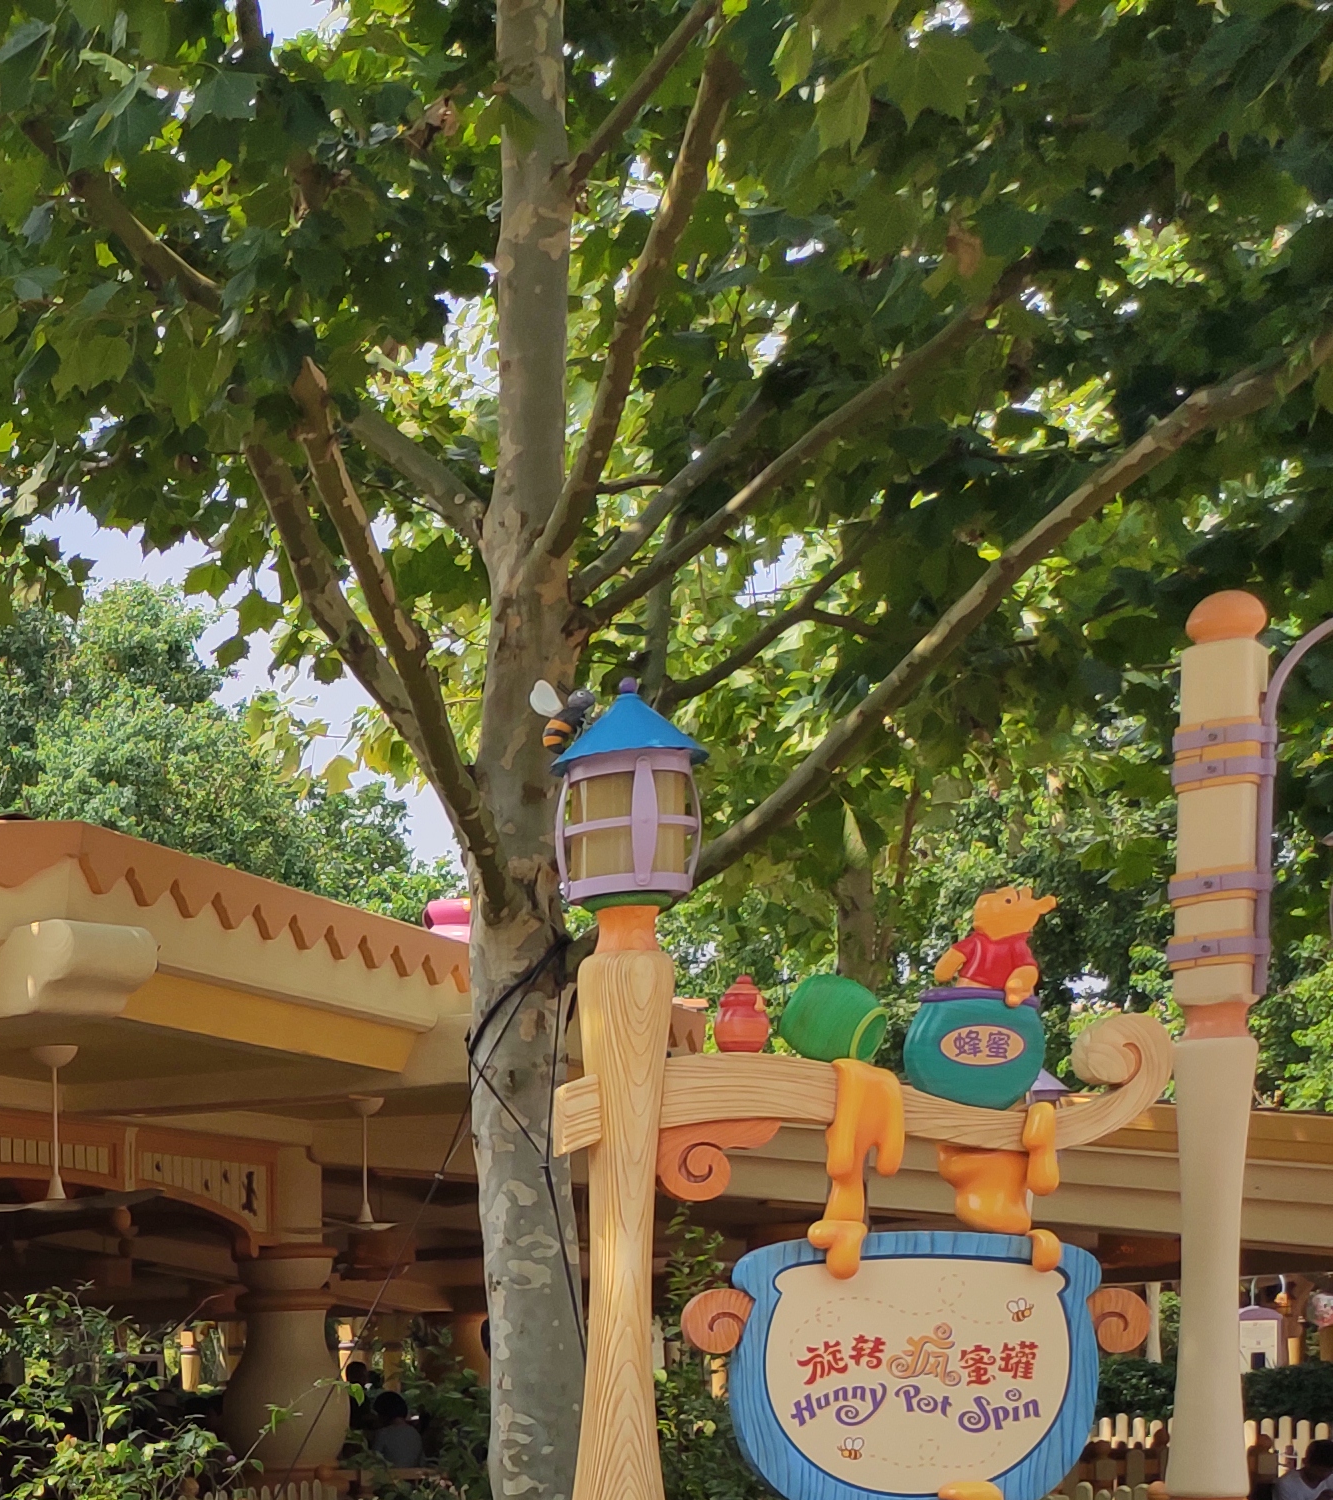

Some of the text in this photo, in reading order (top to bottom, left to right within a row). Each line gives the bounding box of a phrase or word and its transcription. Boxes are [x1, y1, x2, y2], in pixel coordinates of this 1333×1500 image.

[953, 1029, 1012, 1059] 蜂蜜
[796, 1322, 1040, 1387] 旋转疯蜜罐
[790, 1382, 1042, 1433] Hunny Pot Spin
